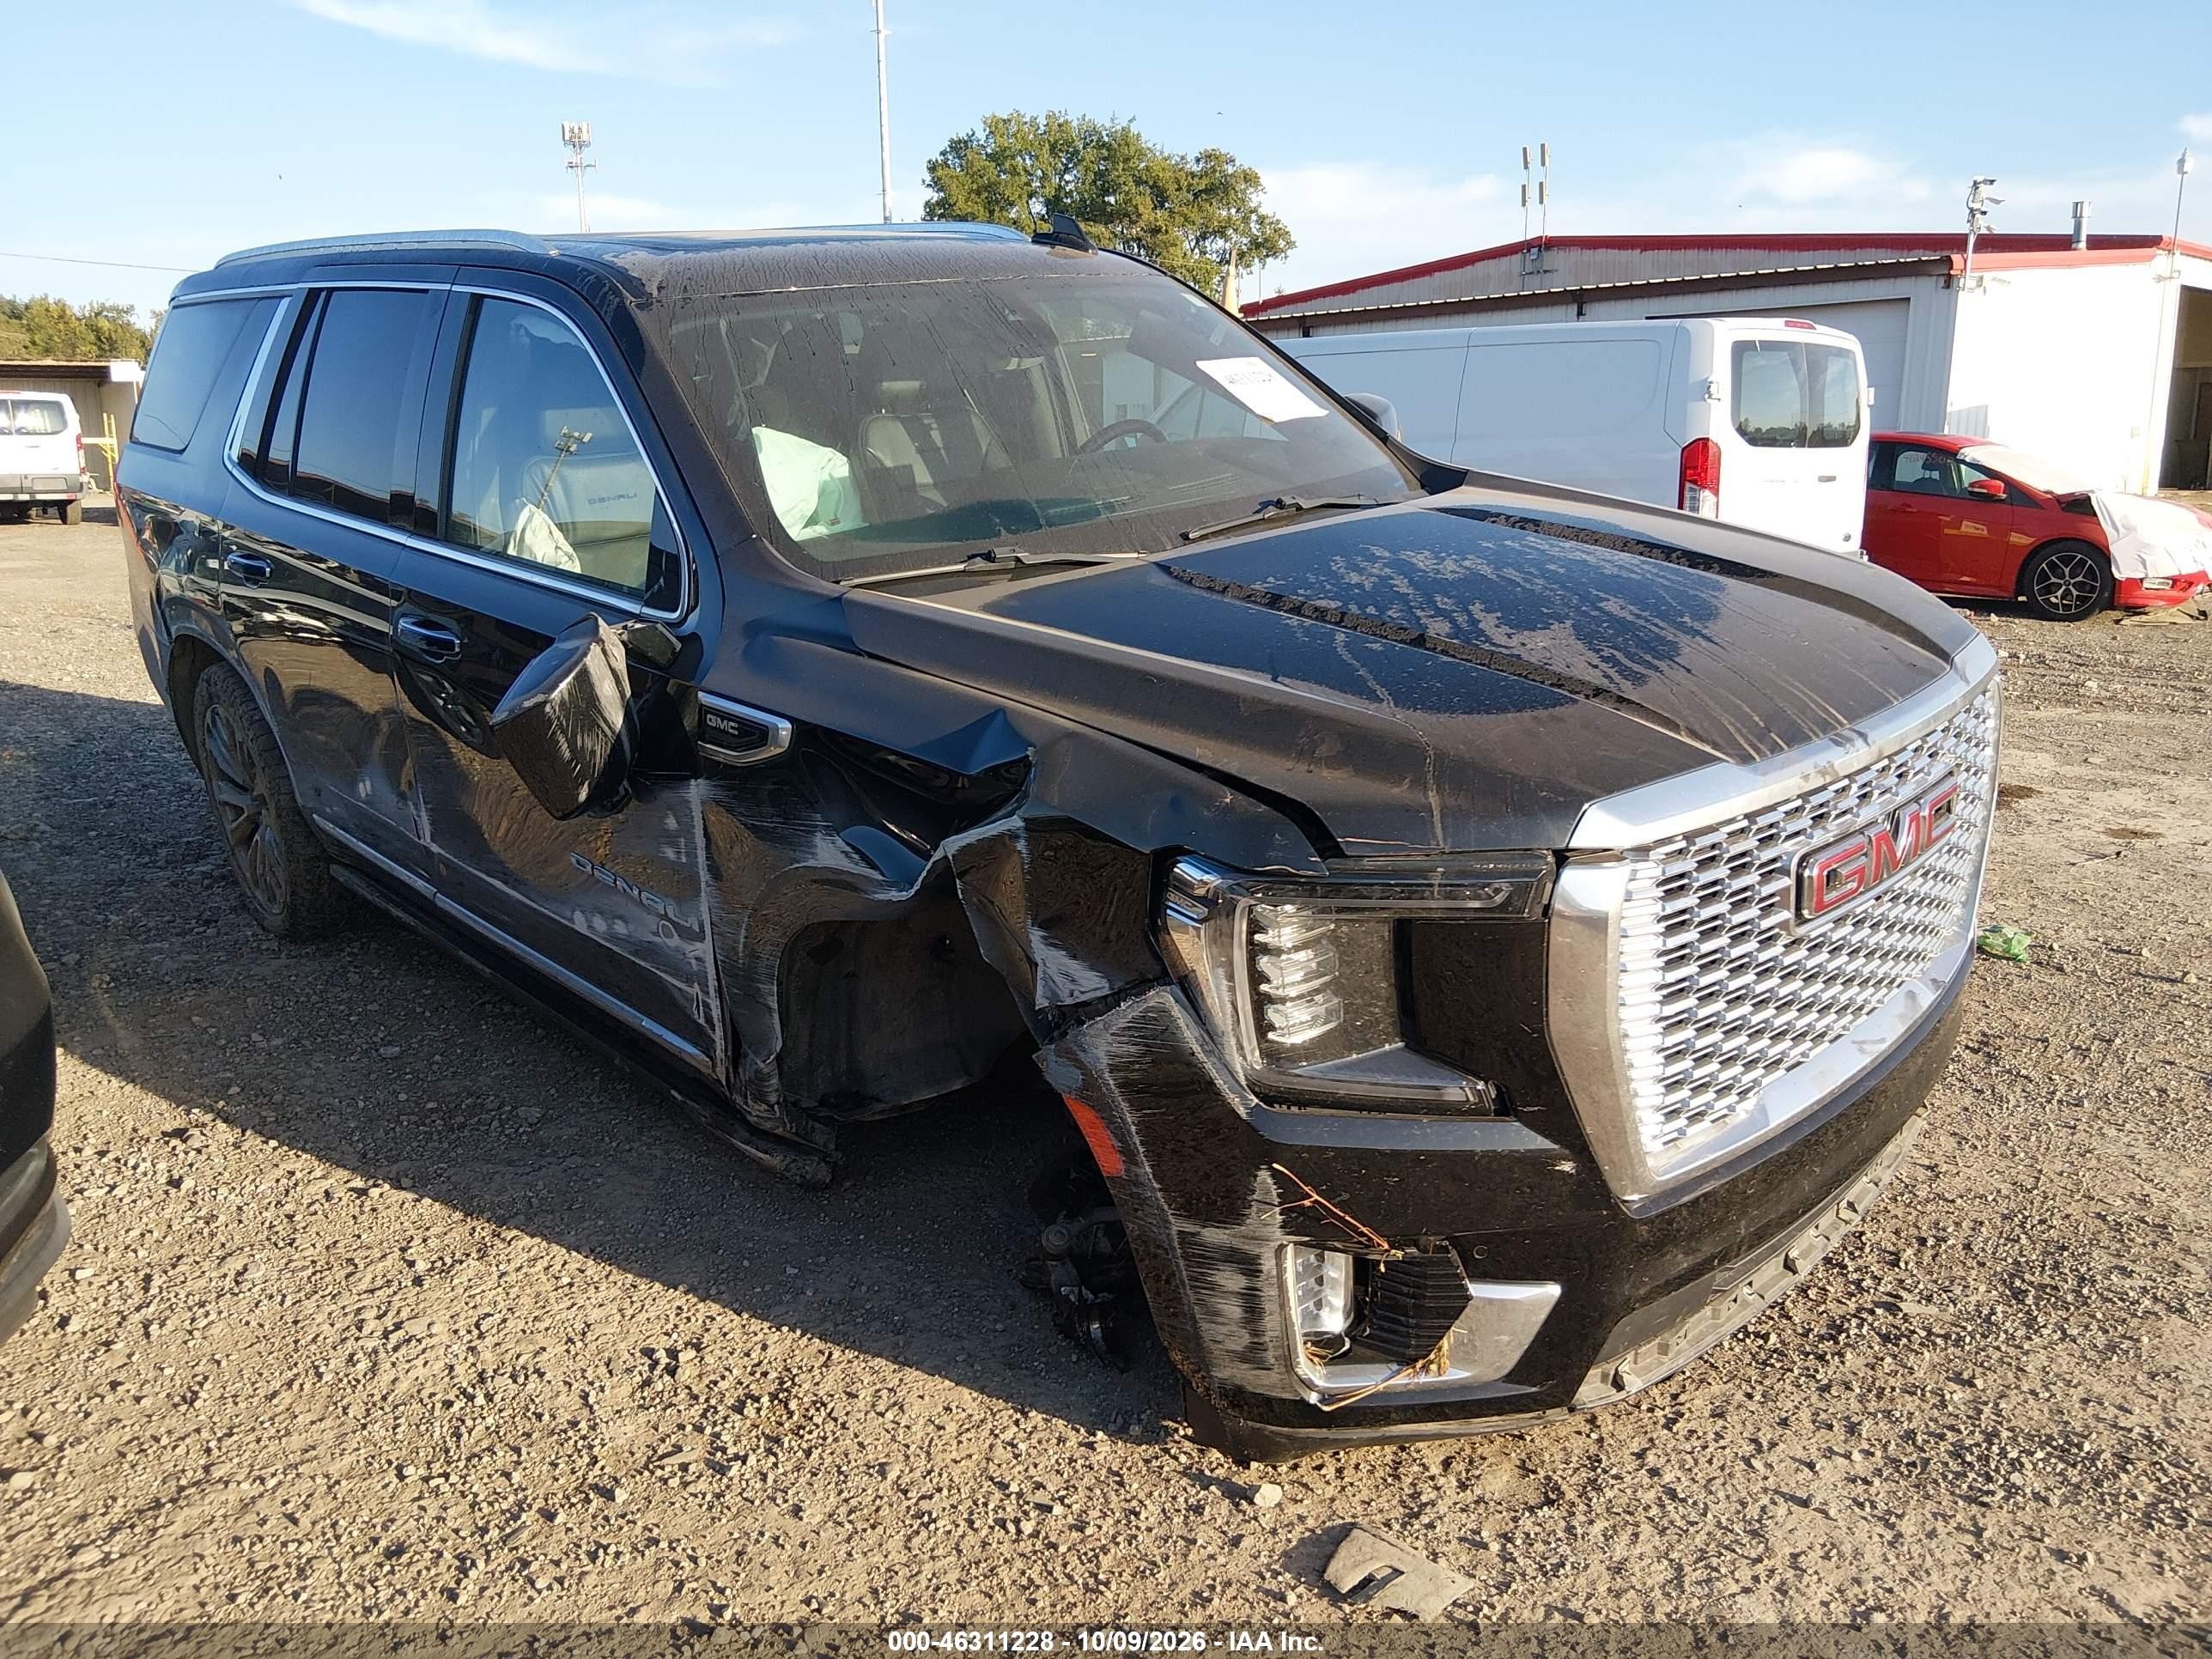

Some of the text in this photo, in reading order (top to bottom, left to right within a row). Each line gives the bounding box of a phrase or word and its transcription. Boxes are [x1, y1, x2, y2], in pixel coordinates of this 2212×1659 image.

[587, 492, 637, 505] DENALI
[706, 714, 738, 735] GMC
[1812, 781, 1960, 914] GMC
[570, 852, 701, 933] DENALI
